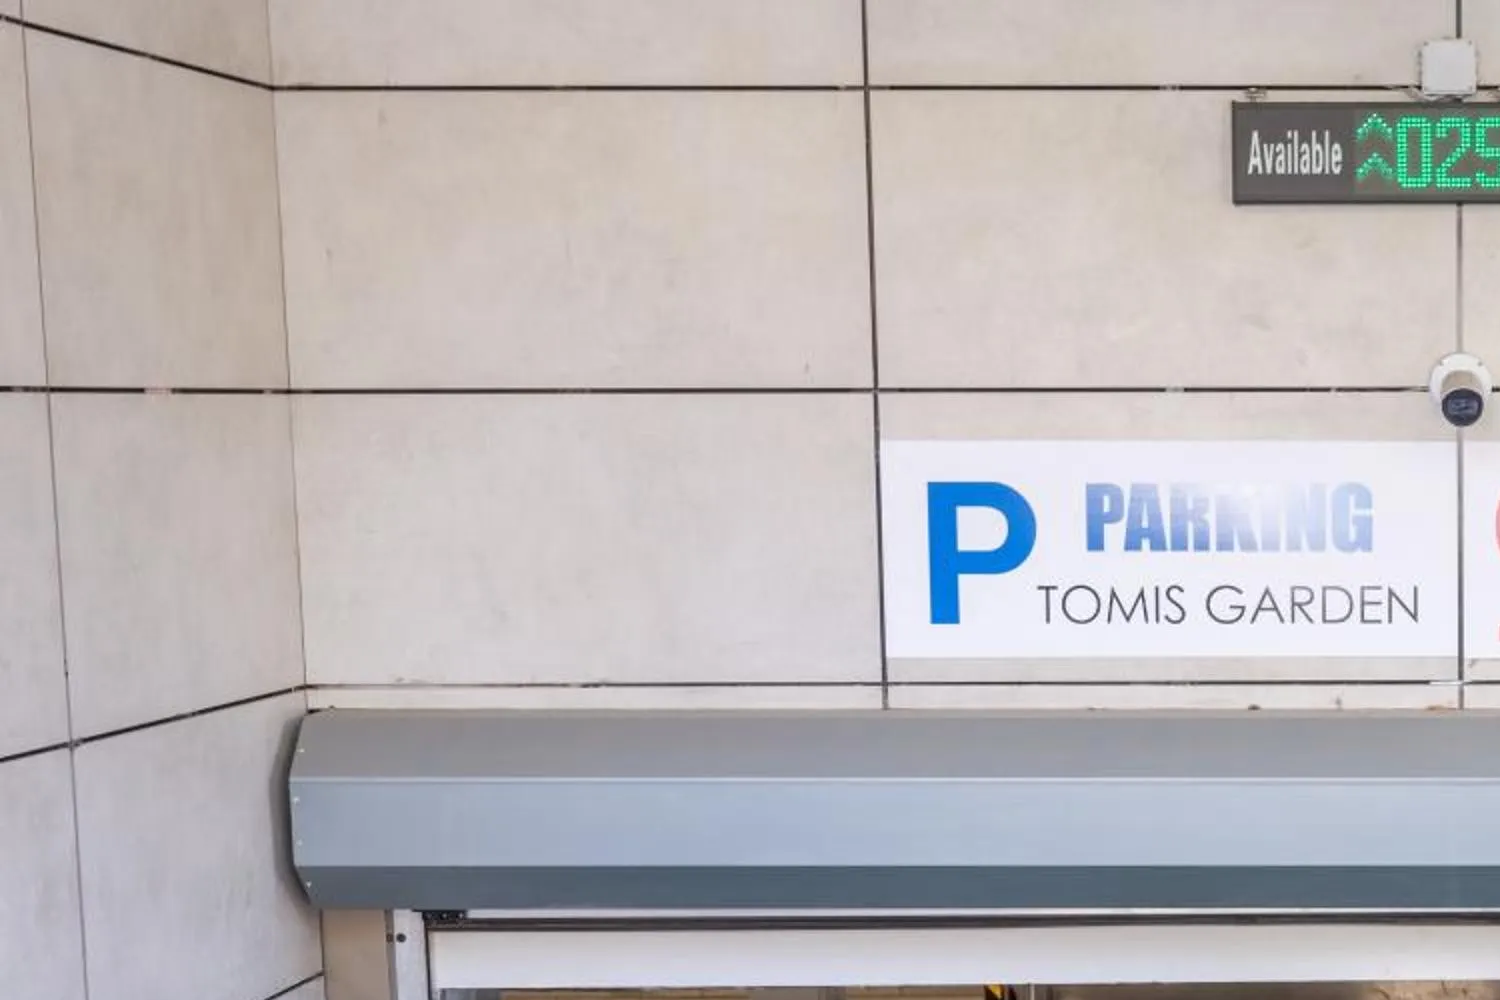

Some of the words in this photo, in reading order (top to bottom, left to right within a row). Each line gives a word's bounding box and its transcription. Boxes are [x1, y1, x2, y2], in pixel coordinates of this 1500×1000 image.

[1248, 130, 1343, 176] Available
[1086, 482, 1374, 554] PARKING
[928, 481, 1037, 626] P
[1037, 584, 1186, 626] TOMIS
[1205, 584, 1420, 626] GARDEN
